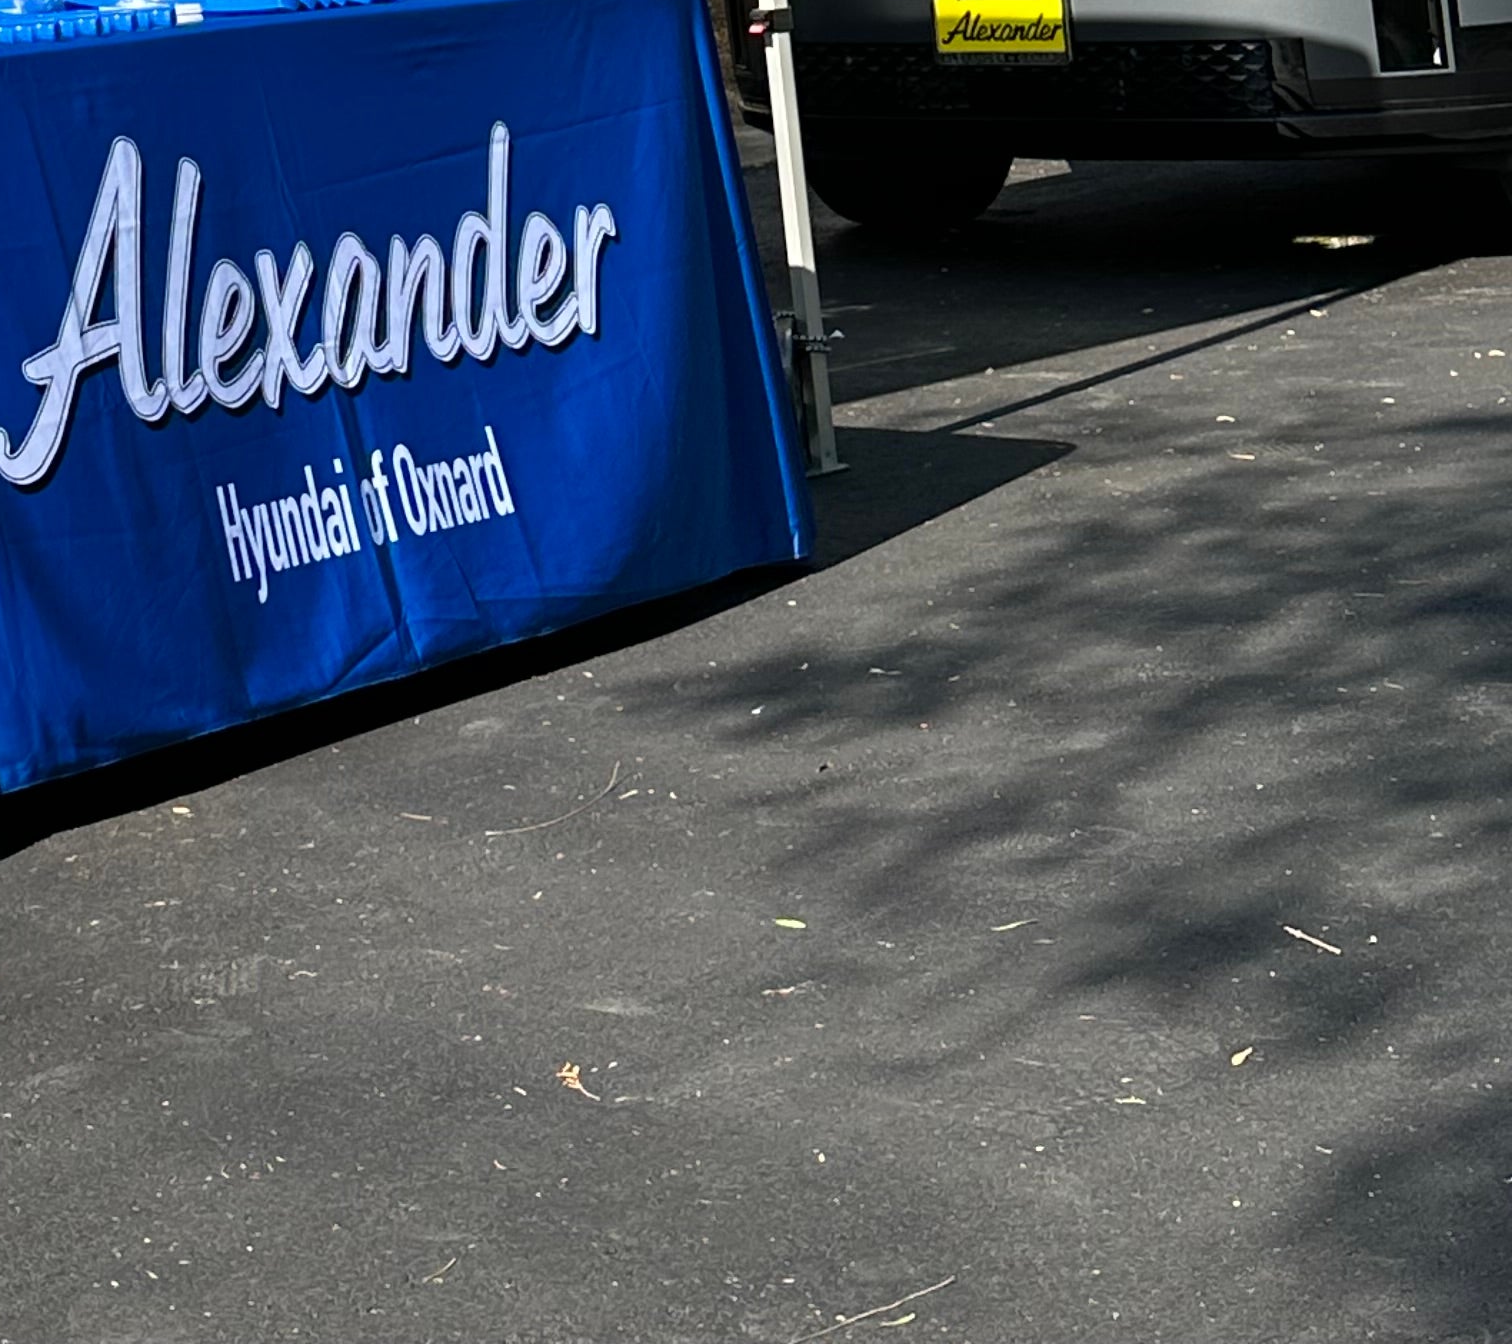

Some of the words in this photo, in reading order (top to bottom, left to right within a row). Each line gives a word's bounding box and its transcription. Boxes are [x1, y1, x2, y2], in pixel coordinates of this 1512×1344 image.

[941, 10, 1063, 45] Alexander
[216, 458, 360, 603] Hyundai
[362, 450, 398, 545] of
[393, 426, 515, 537] Oxnard
